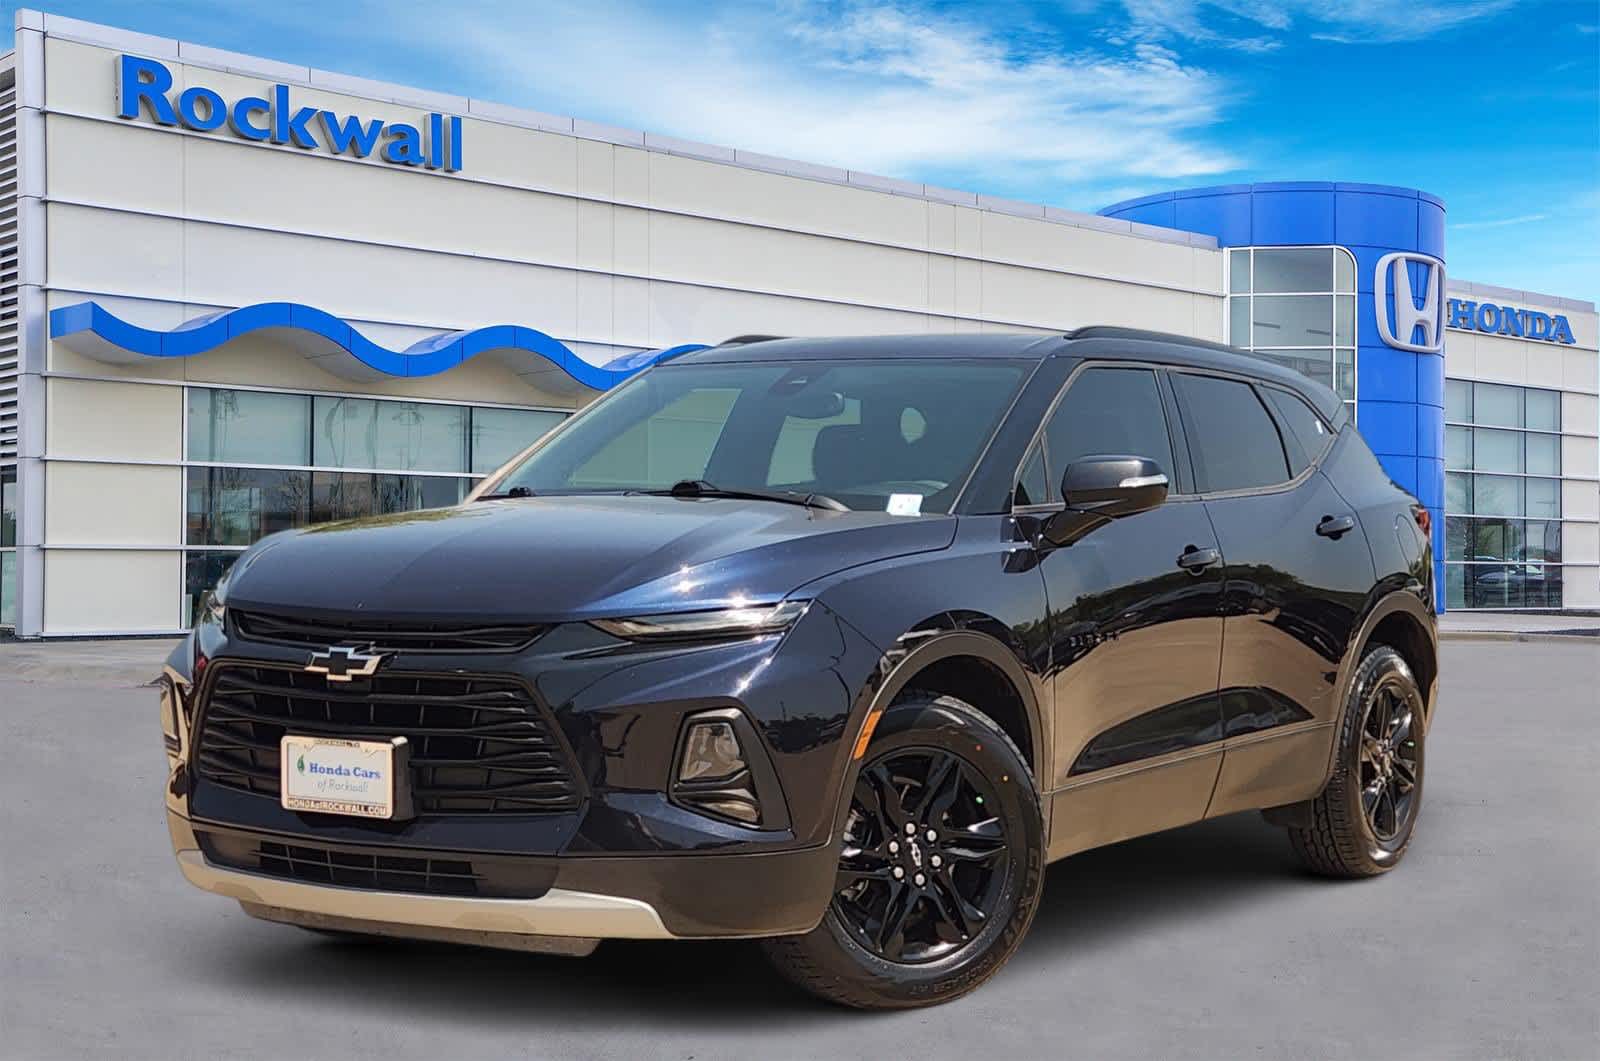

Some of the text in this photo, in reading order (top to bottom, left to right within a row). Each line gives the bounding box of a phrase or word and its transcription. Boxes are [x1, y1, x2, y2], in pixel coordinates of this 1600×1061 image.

[116, 53, 463, 172] Rockwall
[1447, 298, 1577, 345] HONDA
[309, 762, 381, 778] Honda Cars
[317, 780, 328, 793] of
